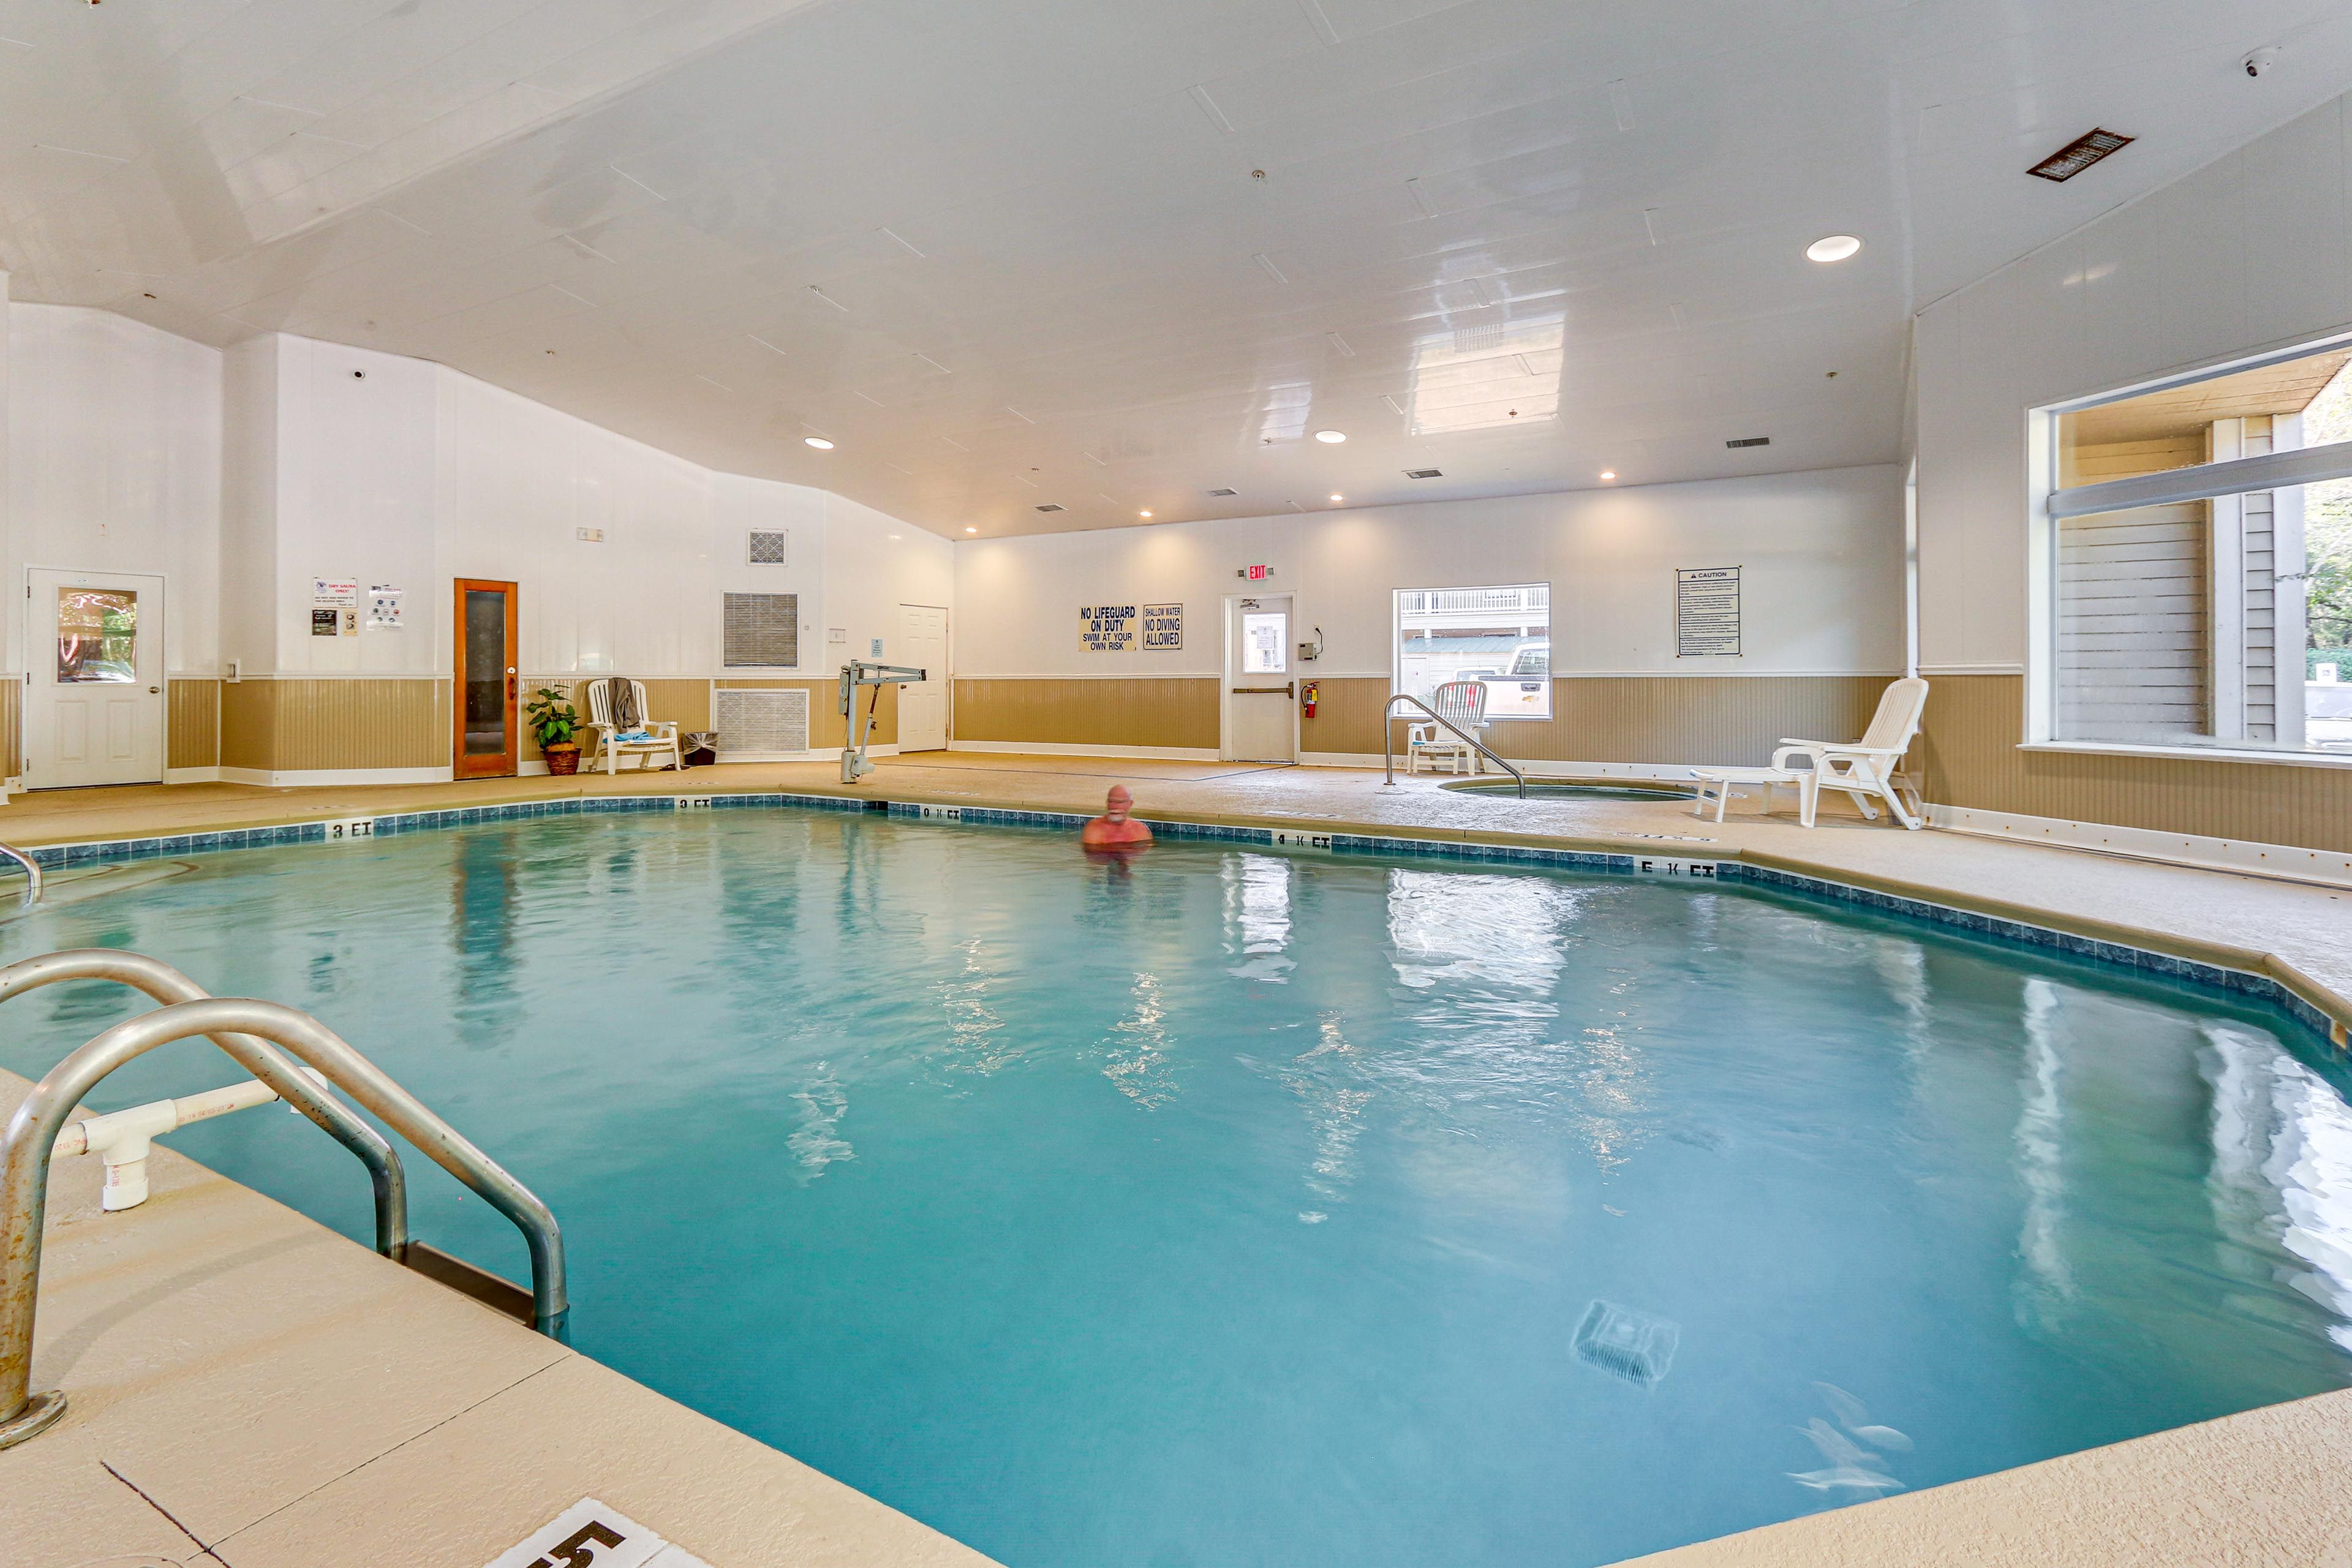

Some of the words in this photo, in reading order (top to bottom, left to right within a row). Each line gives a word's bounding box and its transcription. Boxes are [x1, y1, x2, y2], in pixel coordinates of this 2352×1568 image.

[1250, 565, 1265, 579] EXIT
[1081, 608, 1091, 619] NO
[1095, 606, 1135, 619] LIFEGUARD
[1145, 608, 1164, 616] SHALLOW
[1166, 607, 1180, 616] WATER
[1091, 620, 1101, 632] ON
[1105, 619, 1125, 631] DUTY
[1145, 619, 1155, 631] NO
[1157, 618, 1180, 631] DIVING
[1083, 633, 1099, 642] SWIM
[1114, 633, 1133, 641] YOUR
[1146, 633, 1179, 645] ALLOWED
